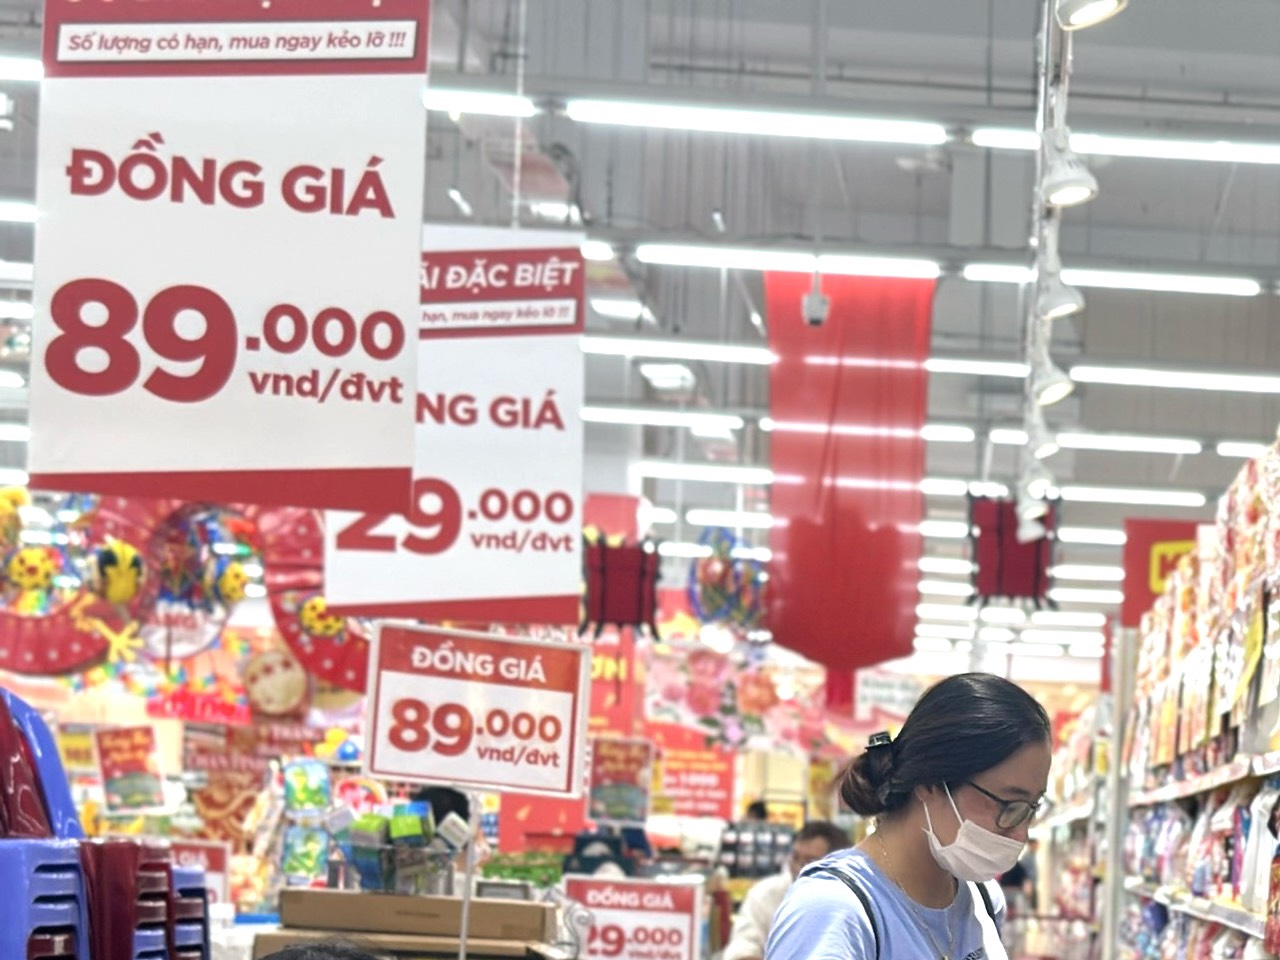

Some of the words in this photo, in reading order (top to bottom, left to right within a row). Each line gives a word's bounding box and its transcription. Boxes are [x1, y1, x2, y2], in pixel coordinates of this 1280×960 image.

[69, 31, 98, 50] Số
[99, 34, 151, 54] lượng
[157, 33, 180, 50] có
[185, 34, 223, 54] hạn,
[229, 36, 271, 50] mua
[275, 36, 323, 52] ngay
[66, 131, 265, 210] ĐỒNG
[281, 156, 396, 219] GIÁ
[420, 262, 441, 290] ÃI
[445, 258, 510, 294] ĐẶC
[514, 255, 581, 292] BIỆT
[248, 368, 405, 404] vnd/đvt
[415, 391, 479, 427] NG
[489, 388, 566, 430] GIÁ
[470, 530, 574, 553] vnd/đvt
[411, 640, 495, 677] ĐỒNG
[499, 655, 547, 683] GIÁ
[476, 746, 561, 768] vnd/đvt
[642, 891, 675, 910] GIÁ
